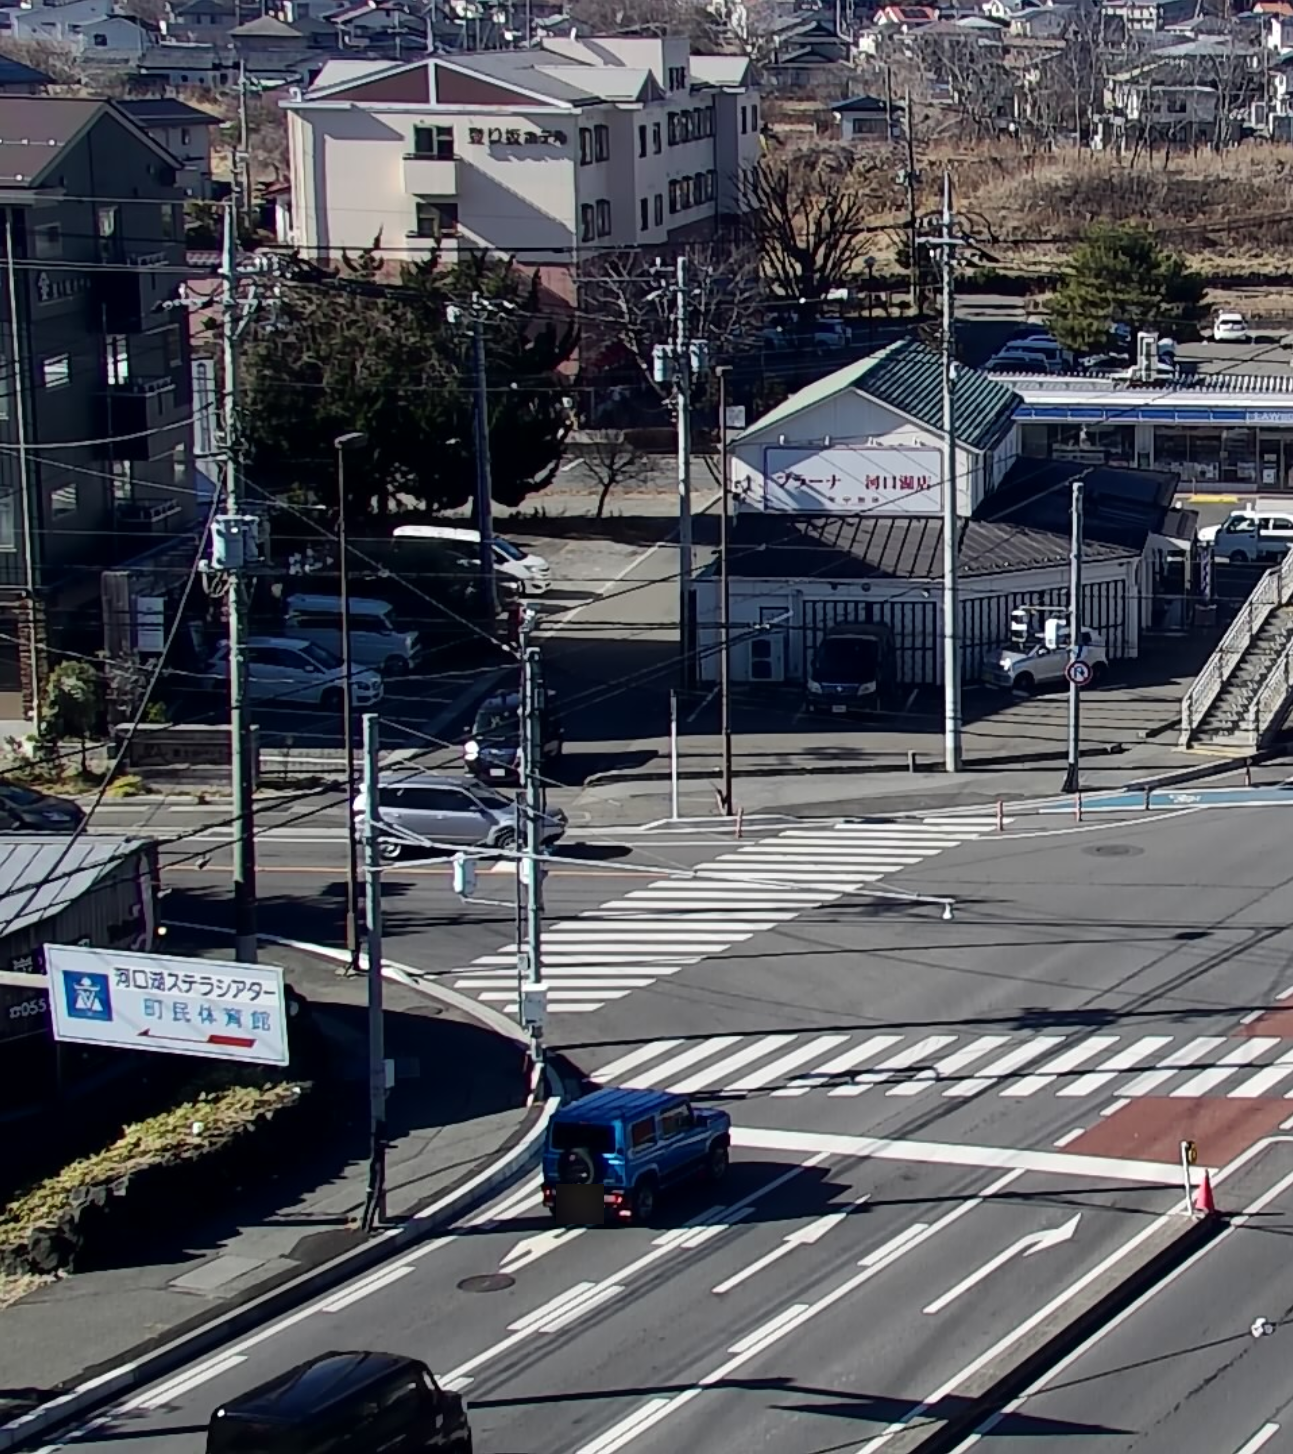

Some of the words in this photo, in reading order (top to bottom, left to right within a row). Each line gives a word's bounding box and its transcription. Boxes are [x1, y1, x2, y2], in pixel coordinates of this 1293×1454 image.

[113, 966, 277, 1002] 河口湖ステラシアター
[143, 997, 272, 1033] 町民体育館
